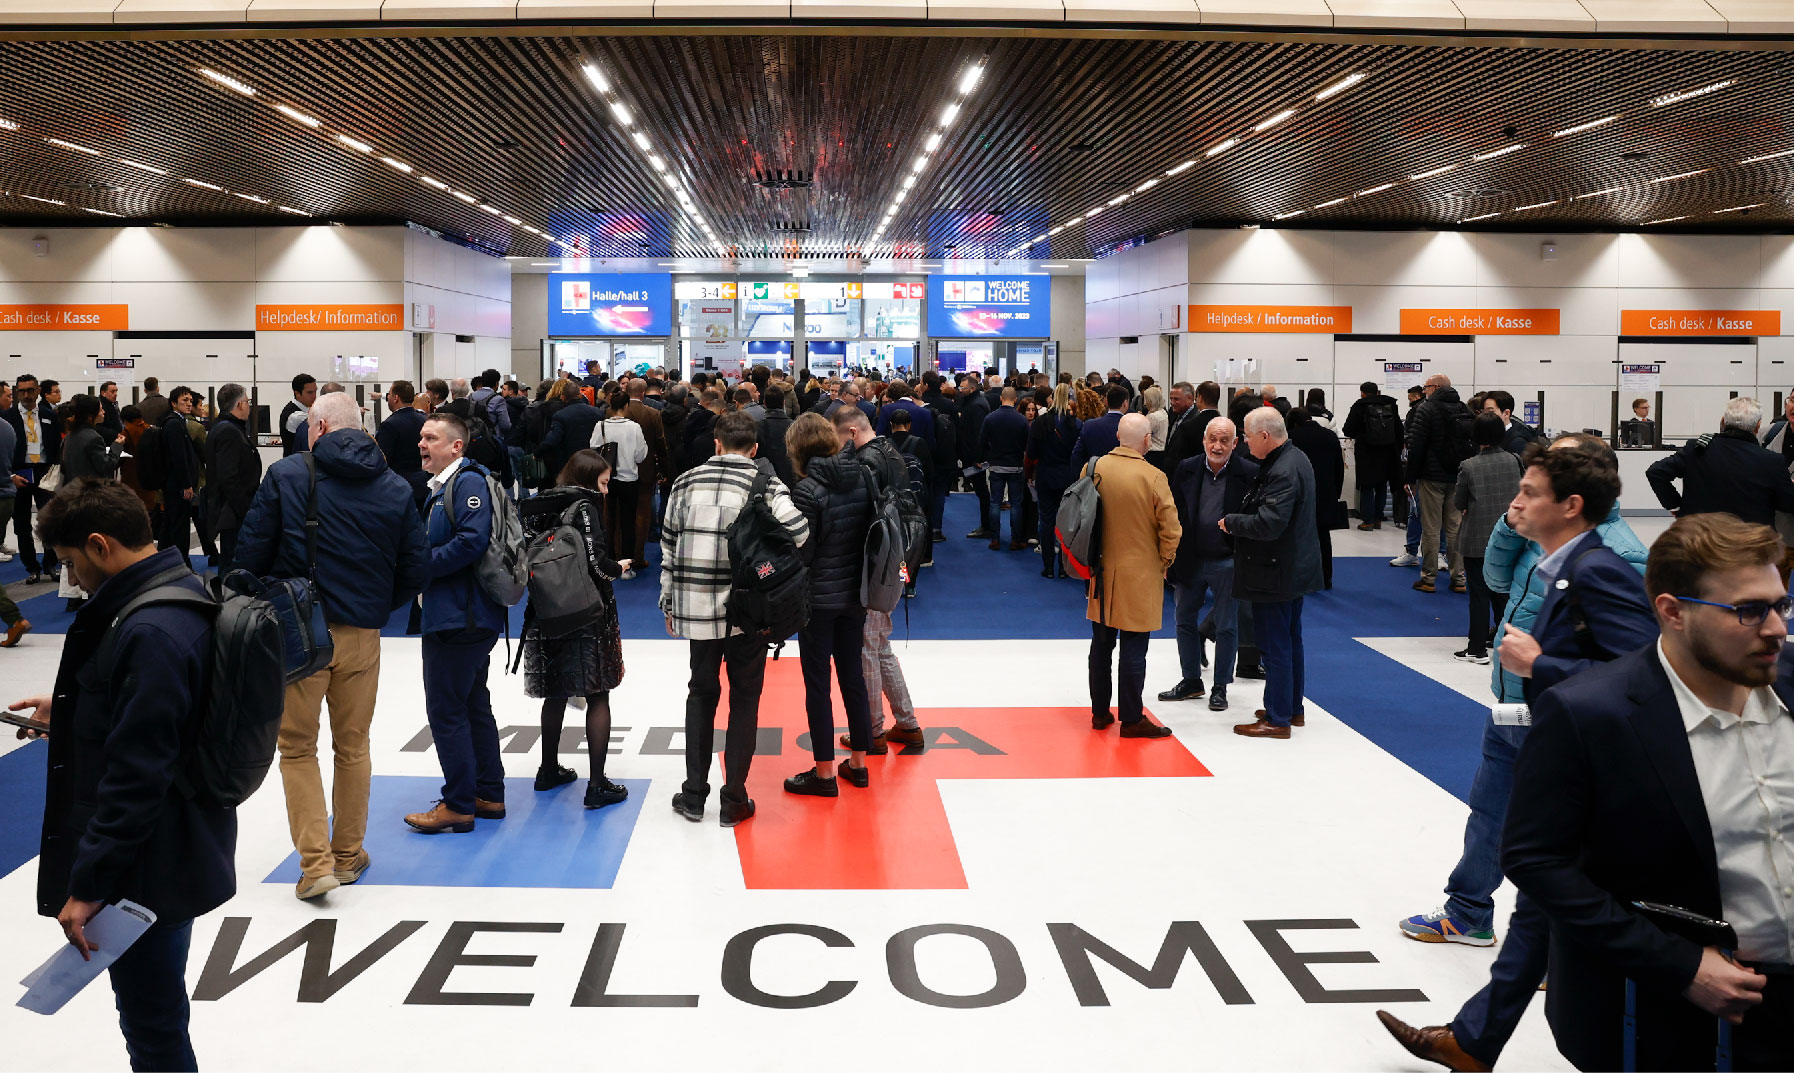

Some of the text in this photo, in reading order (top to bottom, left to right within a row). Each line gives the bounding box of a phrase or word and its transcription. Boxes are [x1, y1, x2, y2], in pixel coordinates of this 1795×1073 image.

[988, 281, 1030, 289] WELCOME
[592, 291, 640, 301] Halle/hall
[642, 291, 649, 301] 3
[701, 287, 719, 298] 3-4
[840, 287, 845, 298] 1
[987, 290, 1030, 302] HOME
[0, 311, 22, 323] ash
[26, 311, 52, 324] desk
[63, 311, 101, 324] Kasse
[325, 309, 398, 324] Information
[1207, 312, 1254, 327] Helpdesk
[1264, 313, 1335, 326] Information
[1428, 315, 1456, 329] Cash
[1459, 315, 1485, 328] desk
[1496, 316, 1533, 329] Kasse
[1649, 316, 1676, 330] Cash
[1679, 316, 1705, 330] desk
[1717, 317, 1753, 330] Kasse
[191, 916, 1430, 1010] WELCOME
